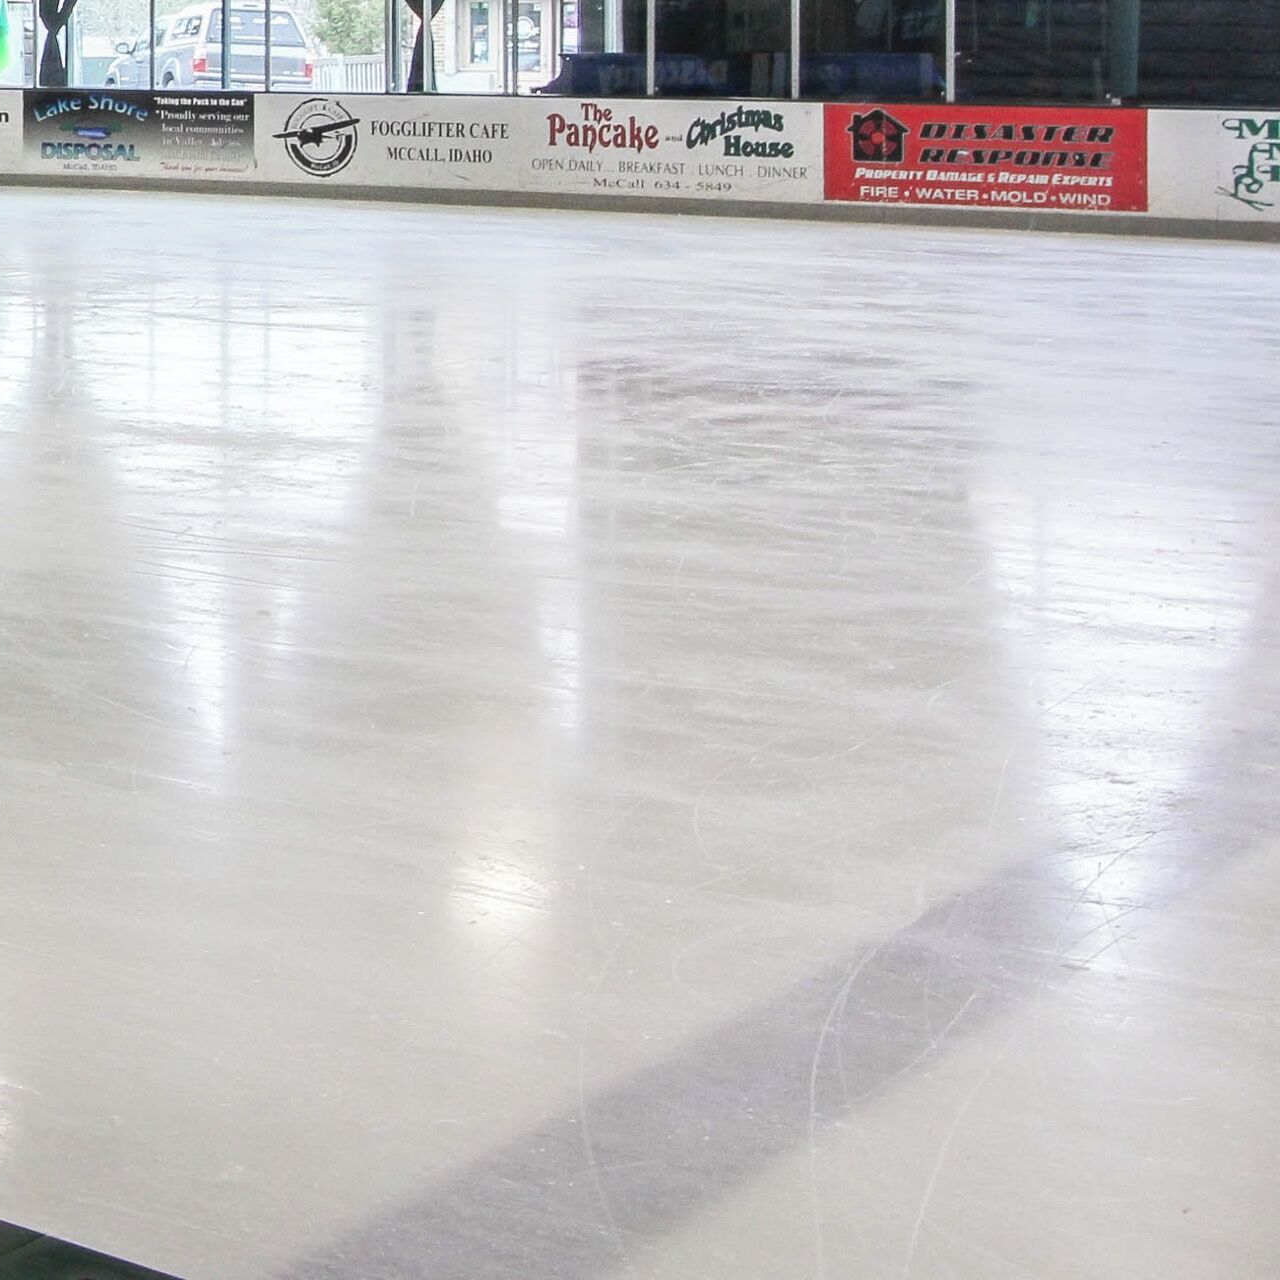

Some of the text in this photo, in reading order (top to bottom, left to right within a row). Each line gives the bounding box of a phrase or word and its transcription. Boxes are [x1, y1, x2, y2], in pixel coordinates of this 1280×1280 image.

[33, 95, 149, 122] Lake Shore
[581, 102, 613, 123] The
[371, 120, 509, 140] FOGGLIFTER CAFE
[547, 113, 660, 154] Pancake
[664, 133, 683, 142] and
[686, 106, 784, 148] Christmas
[919, 123, 1114, 144] DISASTER
[41, 142, 140, 161] DISPOSAL
[449, 149, 493, 164] IDAHO
[724, 135, 794, 158] House
[531, 158, 808, 179] OPEN DAILY BREAKFAST LUNCH DINNER
[919, 147, 1114, 169] RESPONSE
[593, 177, 645, 189] McCall
[654, 180, 680, 190] 634
[696, 181, 732, 192] 5849
[855, 168, 922, 180] PROPERTY
[926, 169, 983, 182] DAMAGE
[998, 171, 1049, 185] REPAIR
[1052, 174, 1114, 186] EXPERTS
[860, 185, 1111, 206] FIRE WATER MOLD WIND
